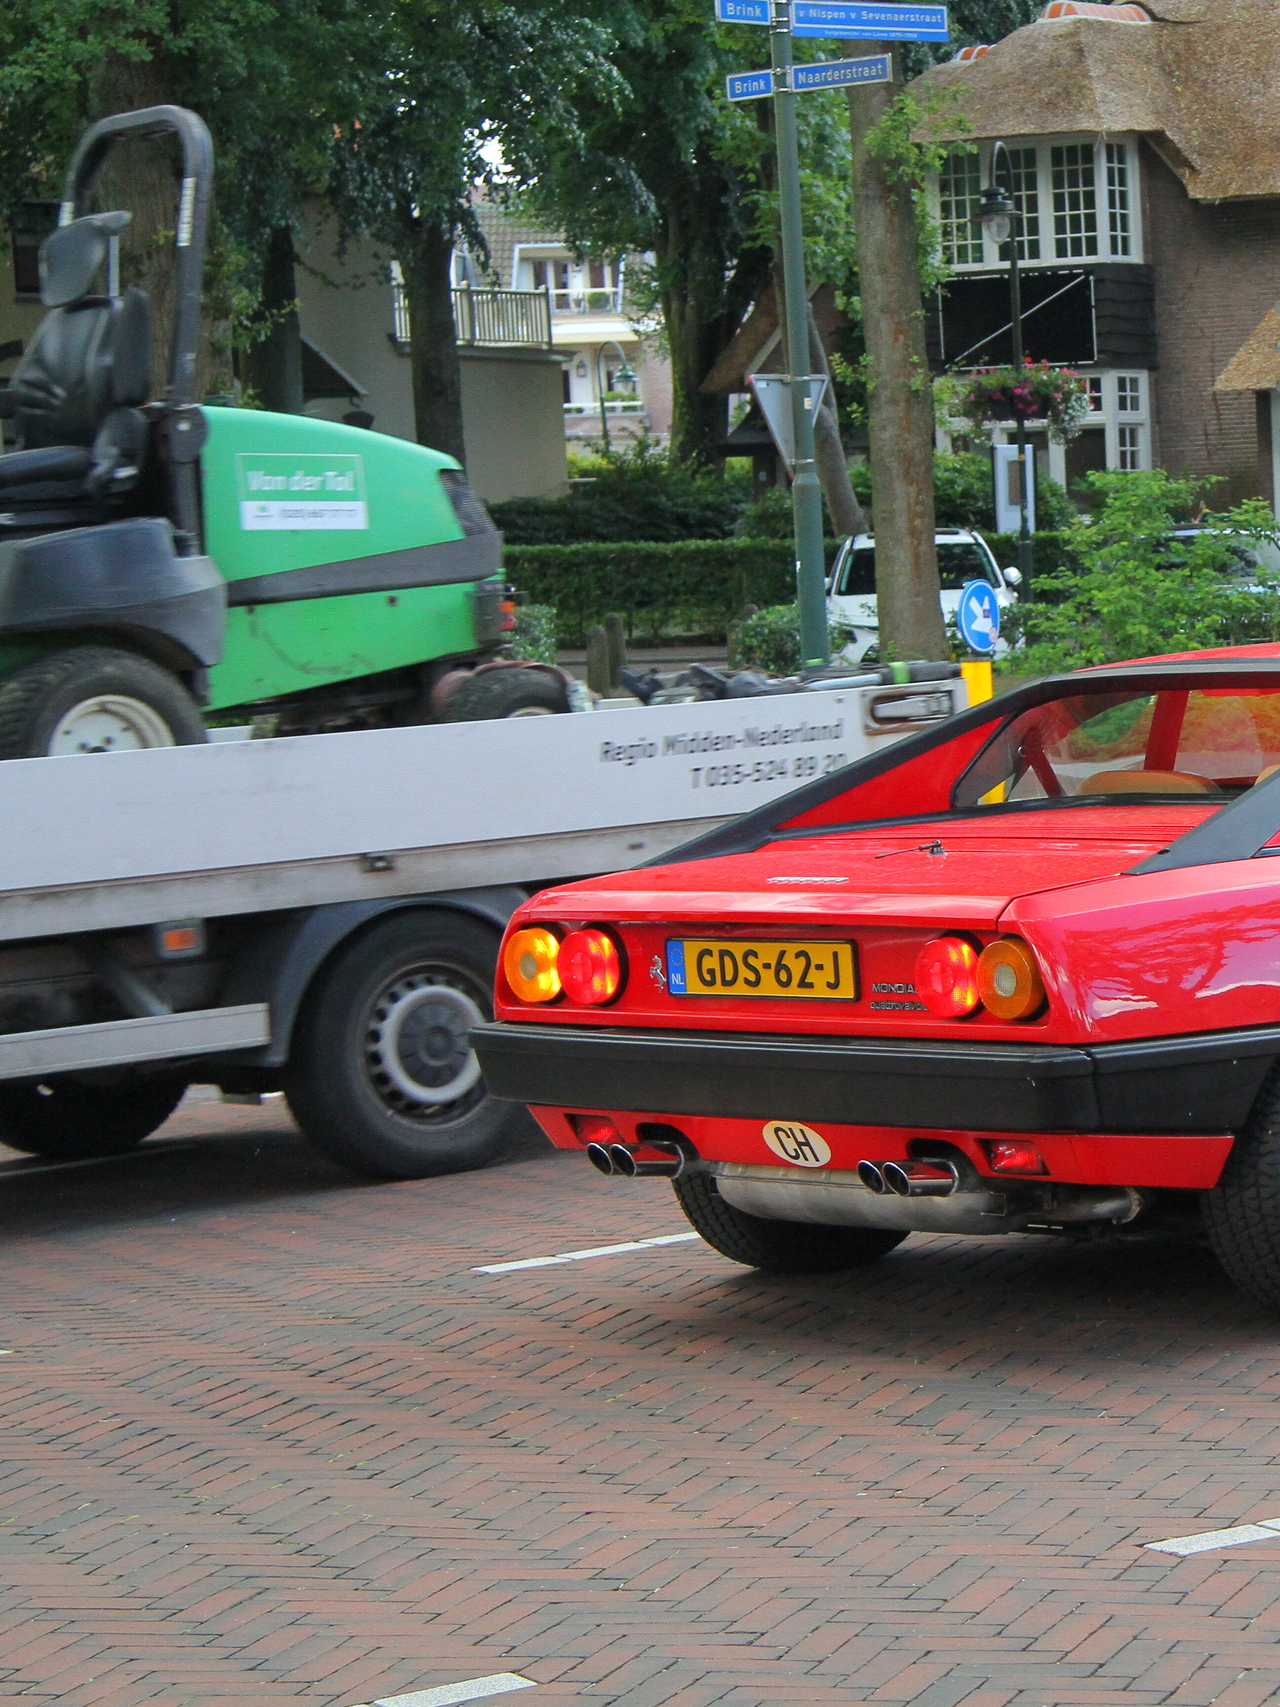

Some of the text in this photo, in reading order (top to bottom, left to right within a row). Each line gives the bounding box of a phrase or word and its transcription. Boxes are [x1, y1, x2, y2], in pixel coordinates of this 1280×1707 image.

[726, 2, 762, 17] Brink
[798, 8, 942, 23] v Nispen v Sevenaerstraat
[798, 62, 883, 84] Naarderstraat
[734, 79, 766, 94] Brink
[246, 470, 355, 491] Van der Tol
[600, 717, 845, 766] Regio Midden-Nederland
[690, 766, 704, 788] T
[705, 758, 788, 787] 035-524
[792, 755, 818, 779] 89
[671, 972, 685, 985] NL
[696, 947, 840, 990] GDS-62-J
[773, 1126, 820, 1162] CH
